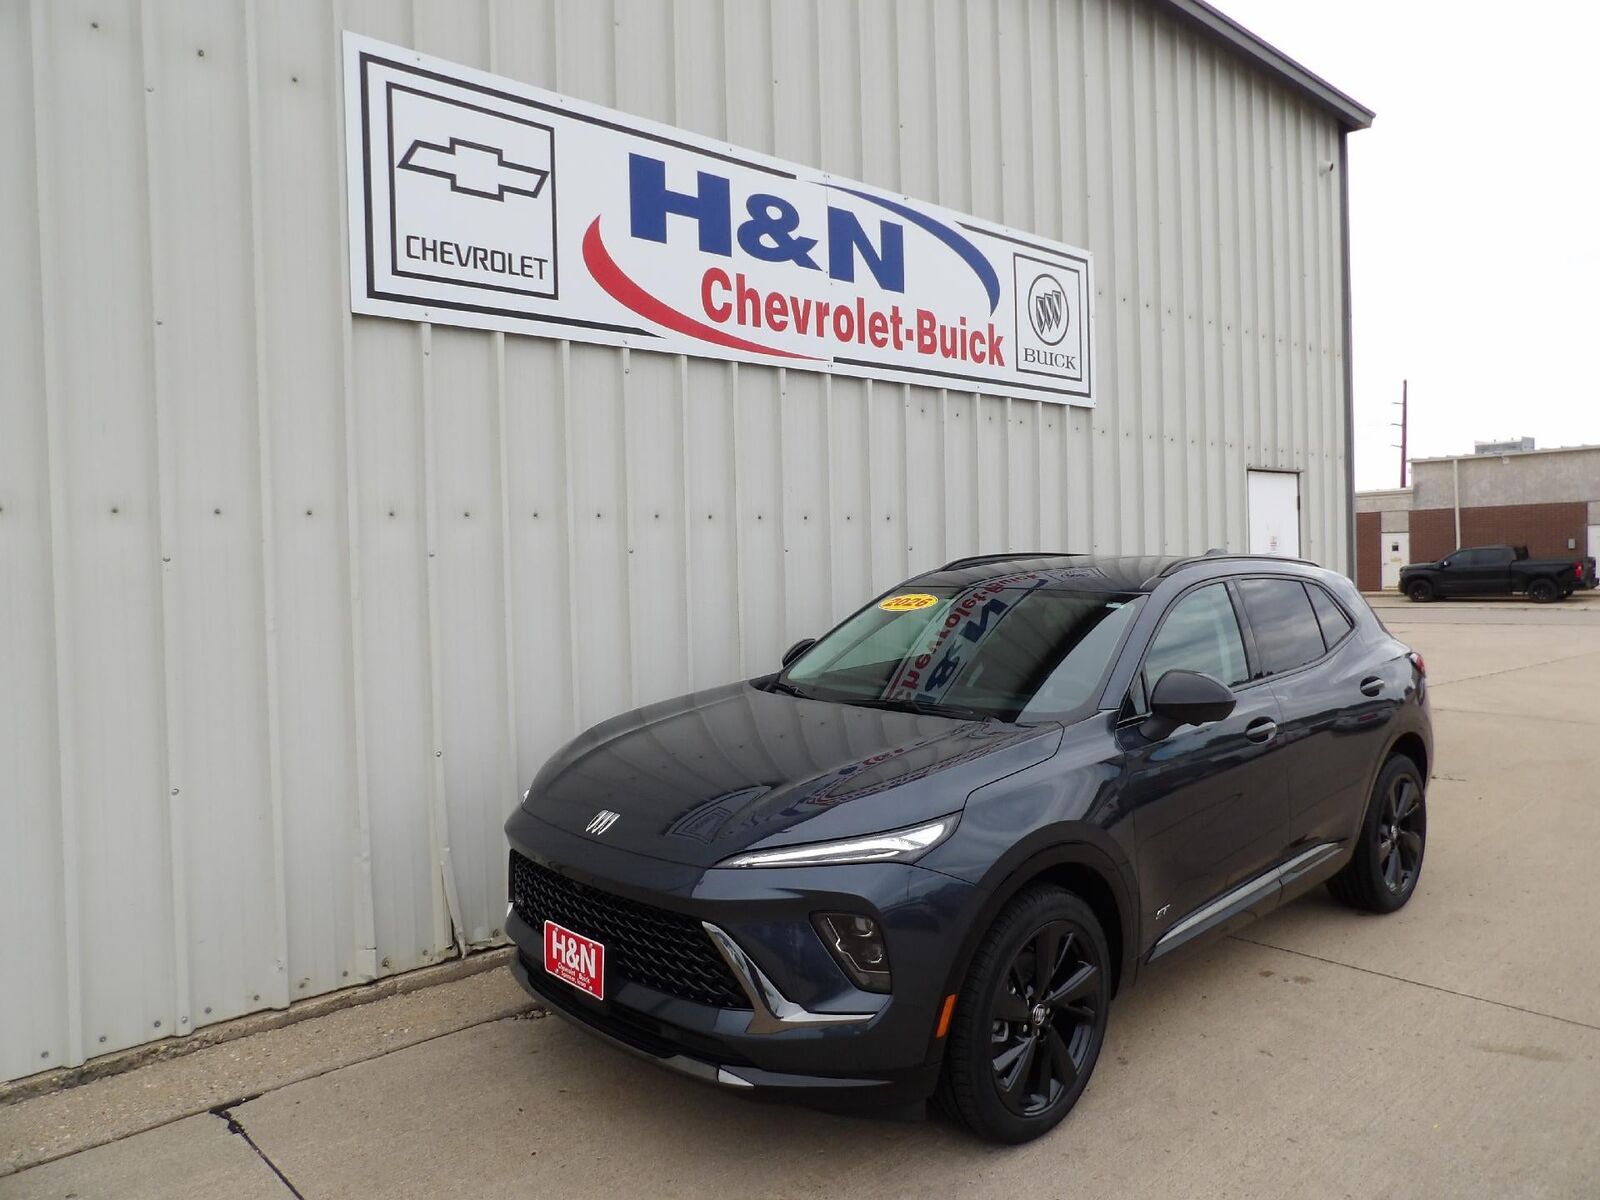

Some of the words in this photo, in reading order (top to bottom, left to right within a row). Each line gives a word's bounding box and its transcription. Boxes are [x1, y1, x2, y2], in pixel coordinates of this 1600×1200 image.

[628, 152, 905, 294] H&N
[405, 235, 548, 280] CHEVROLET
[701, 267, 1006, 367] Chevrolet-Buick
[1023, 347, 1077, 370] BUICK
[882, 597, 933, 607] 2026
[552, 930, 596, 979] H&N
